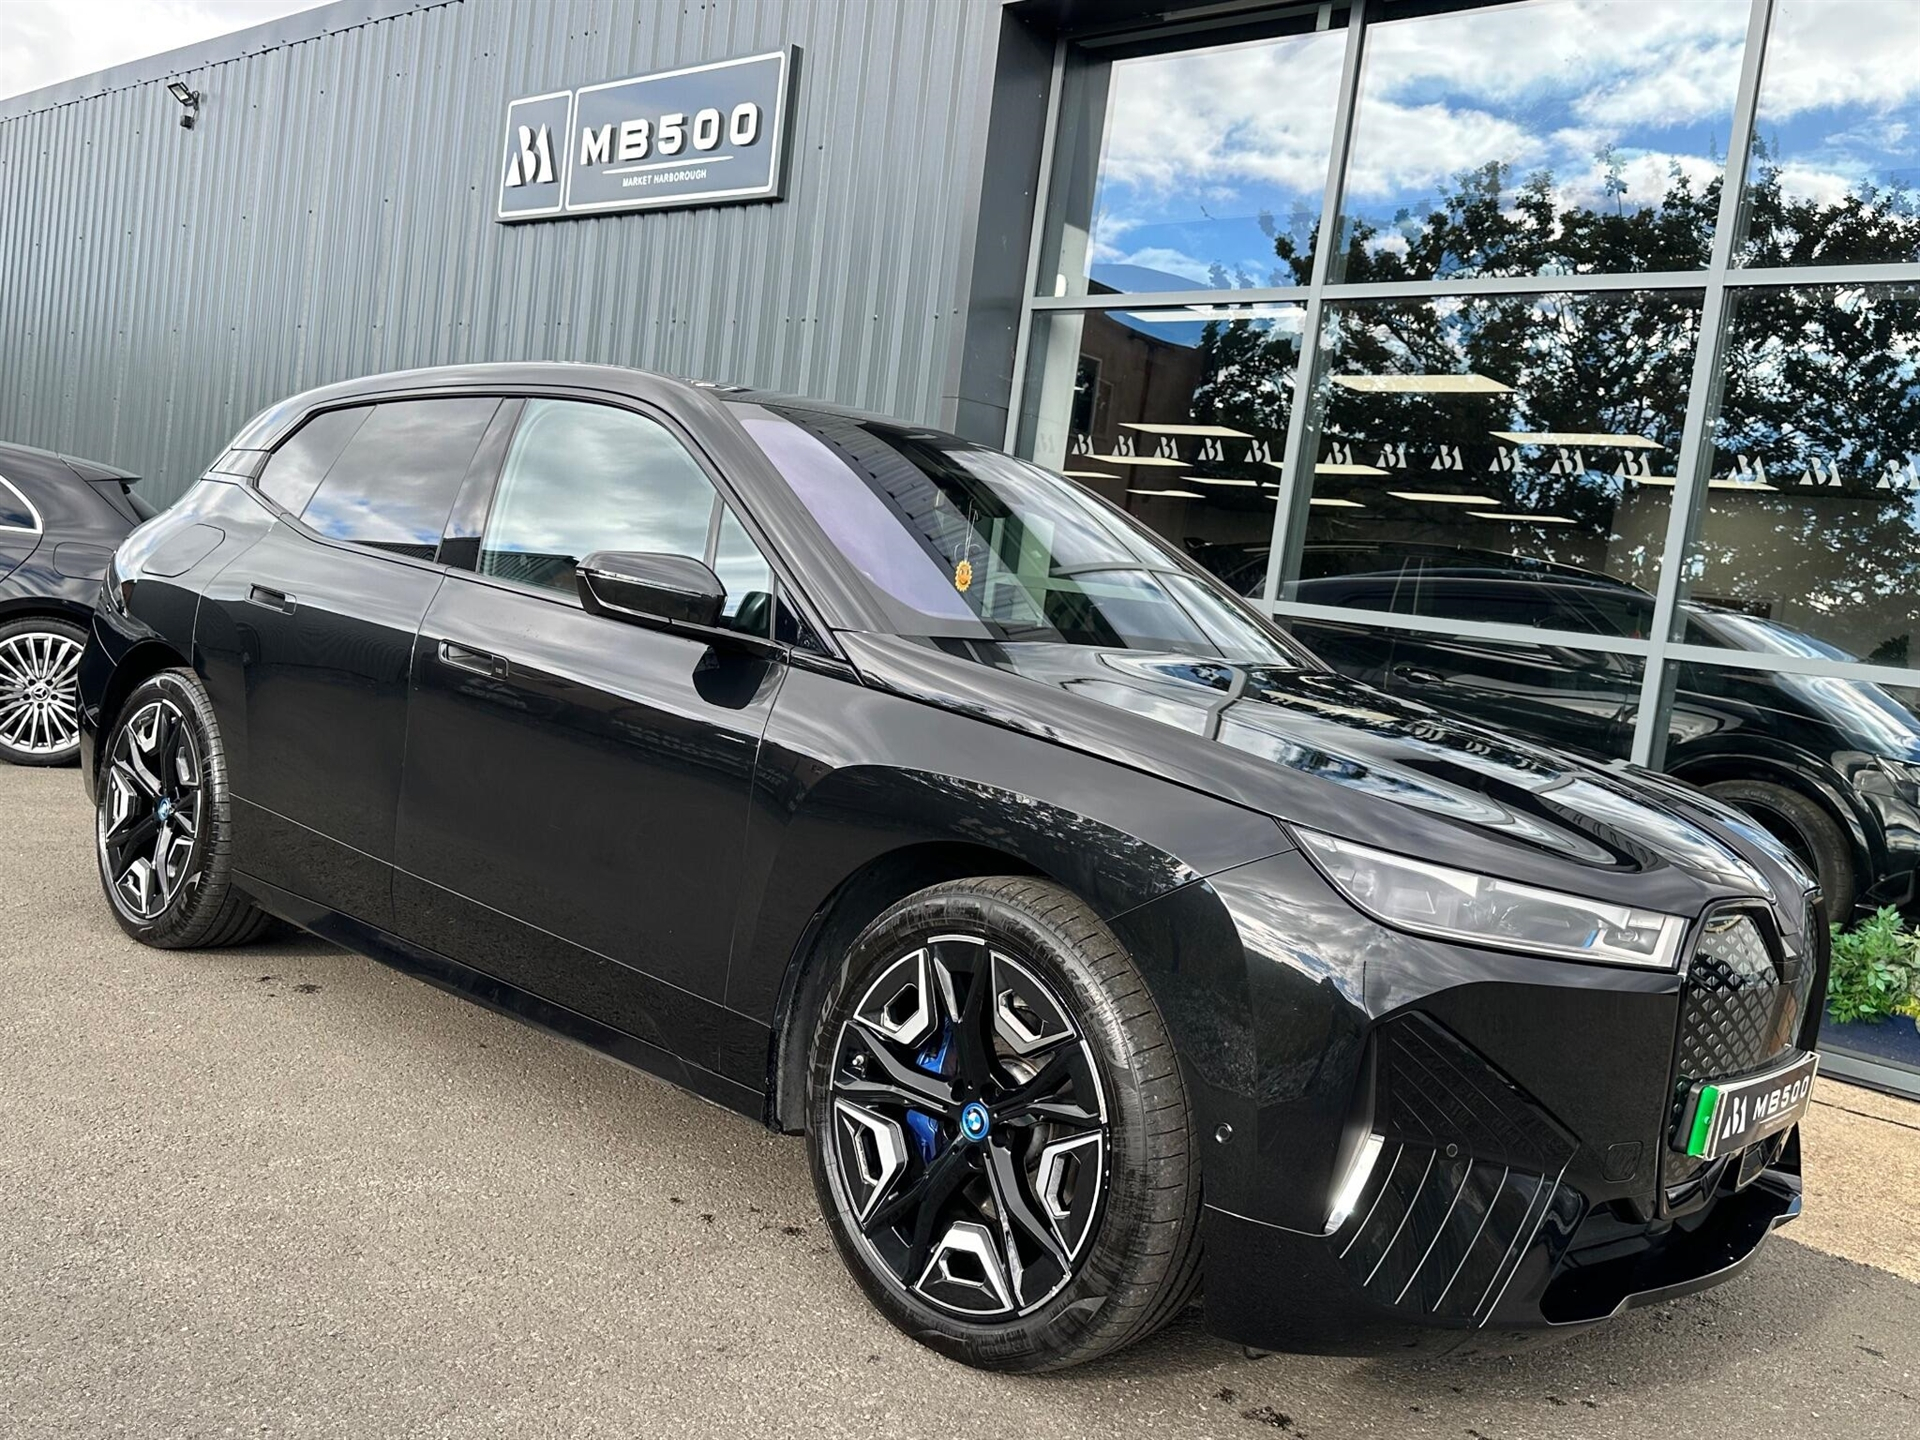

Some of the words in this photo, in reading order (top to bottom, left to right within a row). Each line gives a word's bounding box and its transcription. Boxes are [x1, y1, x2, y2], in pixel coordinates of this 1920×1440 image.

[580, 102, 758, 165] MB500
[622, 174, 652, 187] MARKET
[653, 169, 707, 184] HARBOROUGH
[1752, 1075, 1810, 1121] MB500
